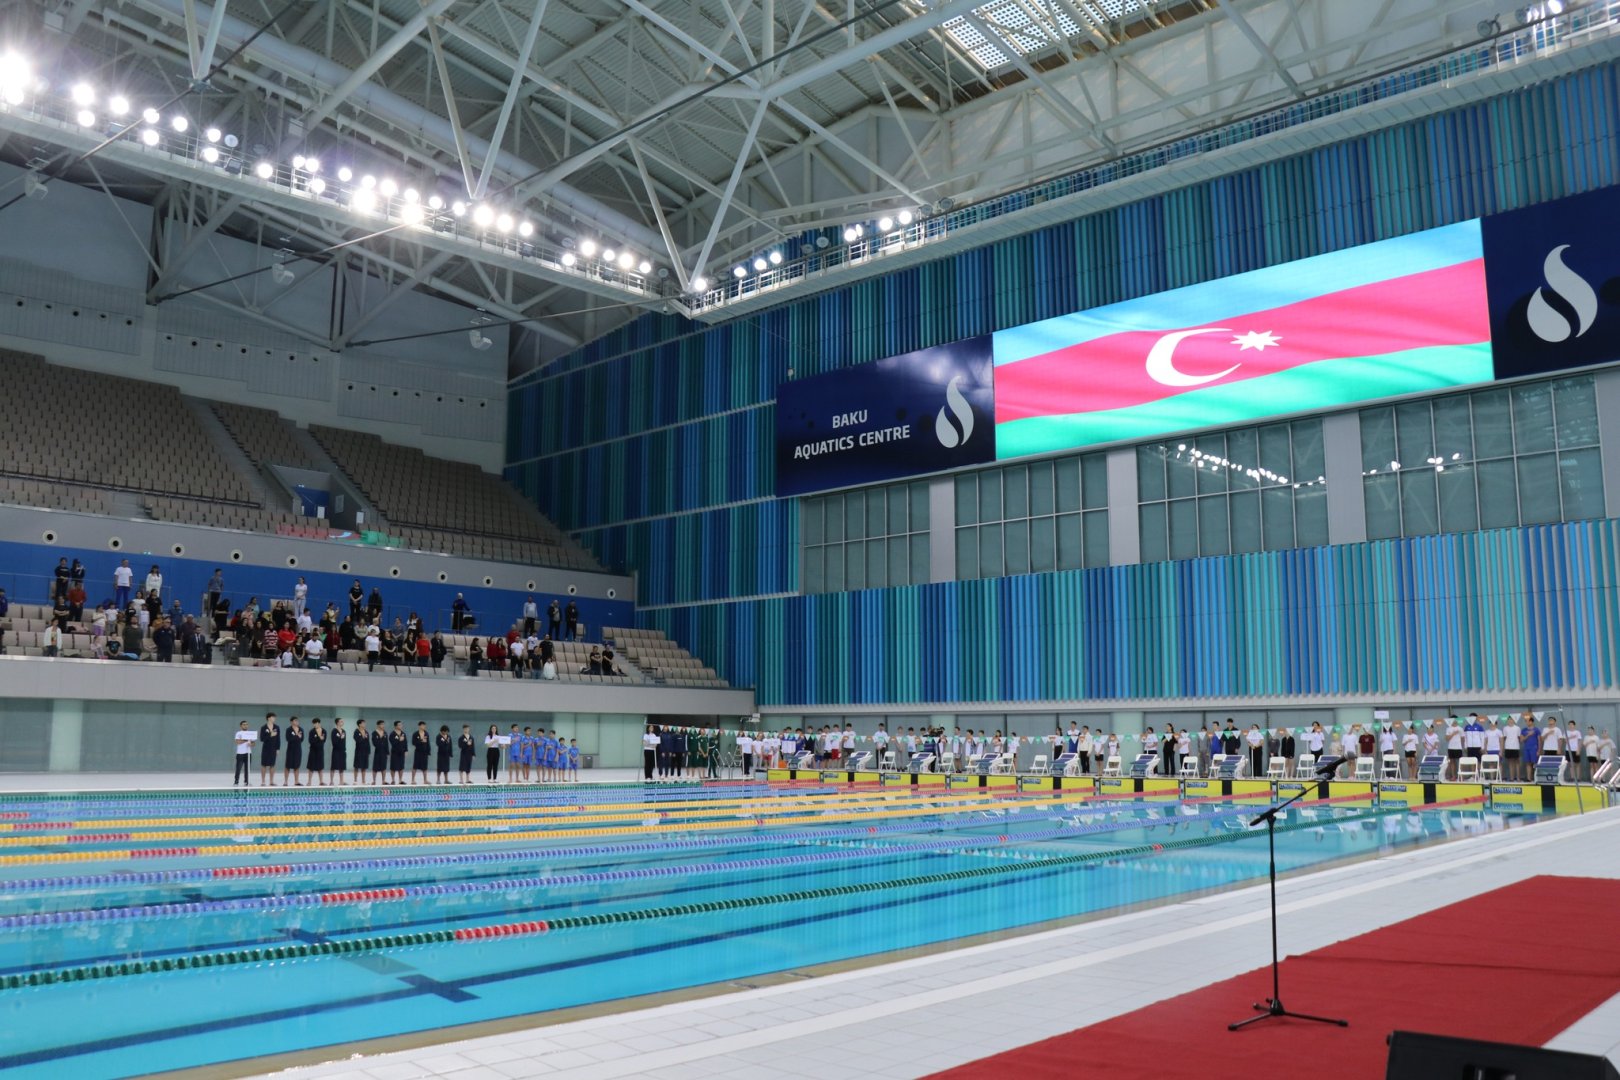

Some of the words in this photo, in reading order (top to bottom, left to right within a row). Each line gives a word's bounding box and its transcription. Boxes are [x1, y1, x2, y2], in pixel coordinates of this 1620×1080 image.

[832, 409, 868, 429] BAKU
[794, 435, 855, 460] AQUATICS
[859, 425, 911, 447] CENTRE
